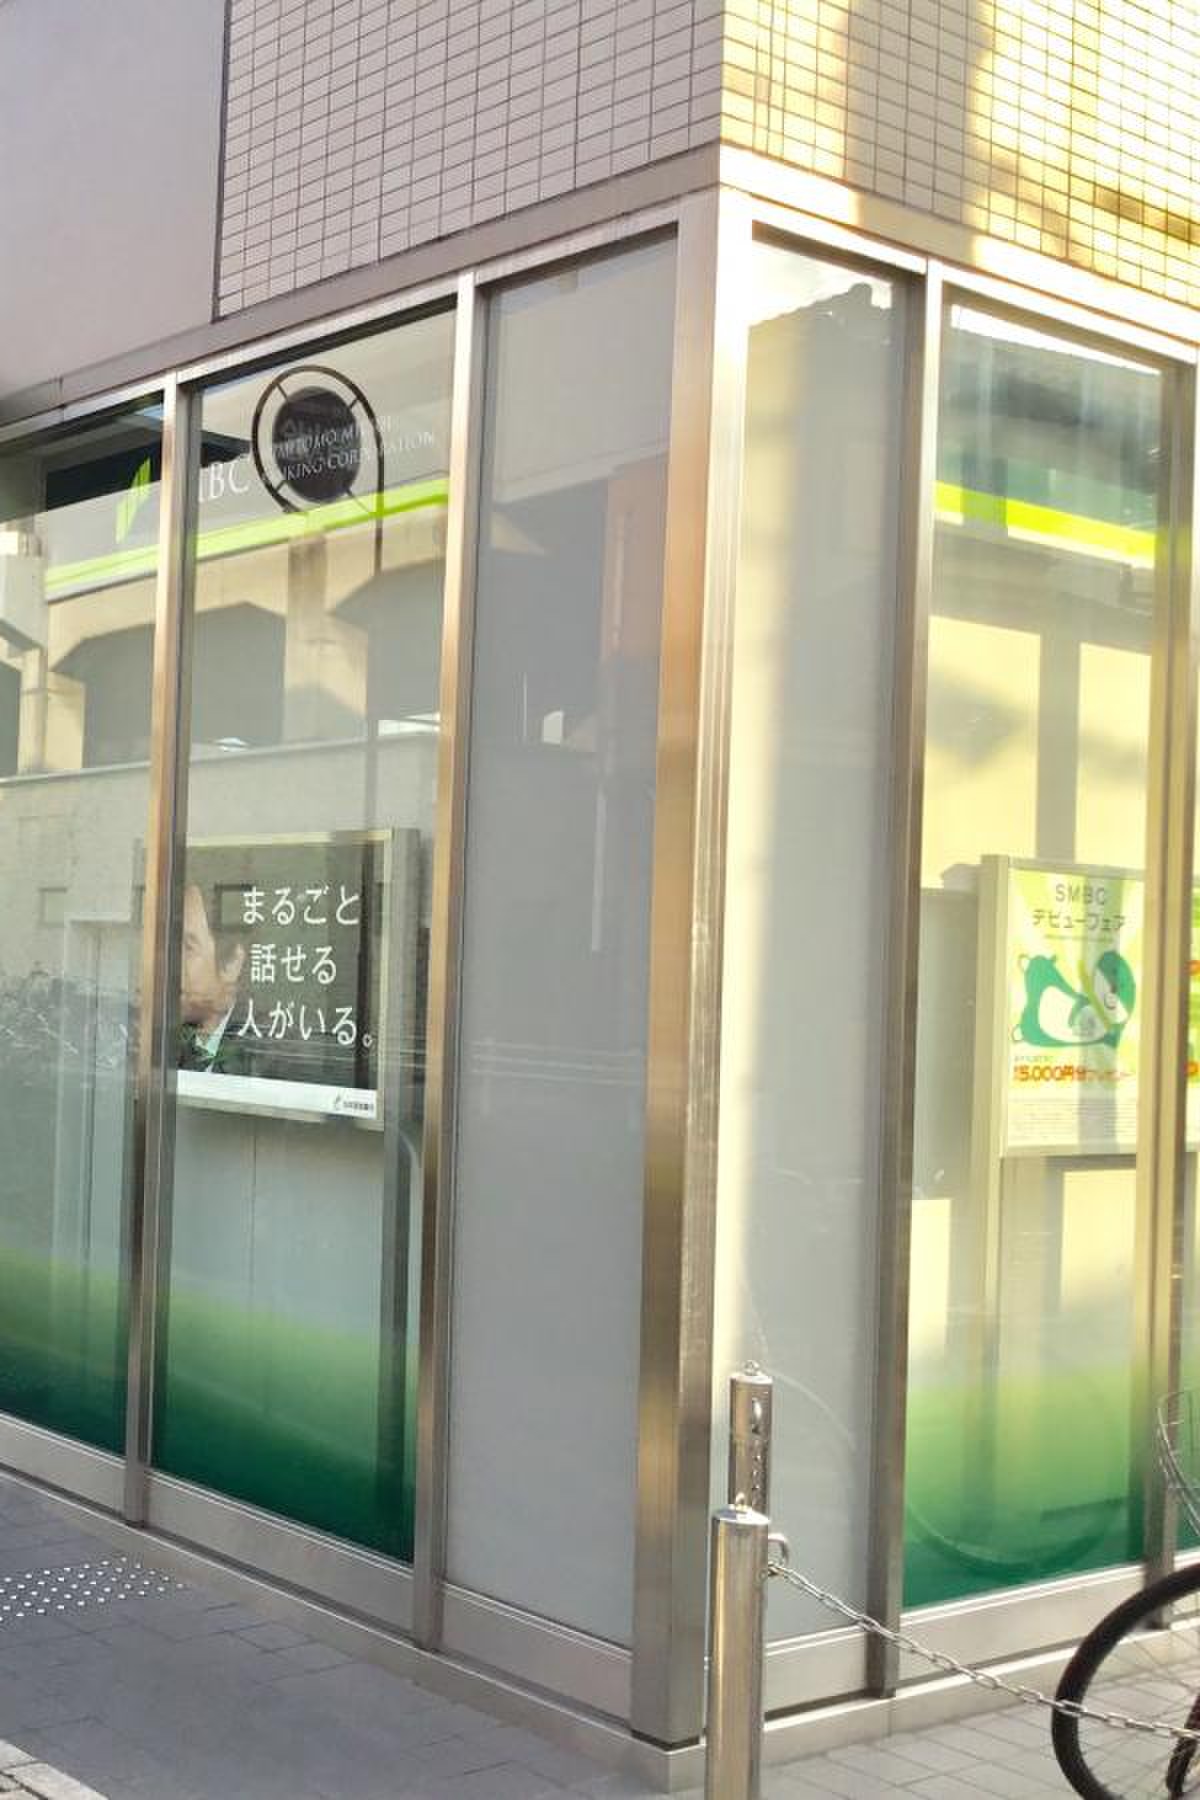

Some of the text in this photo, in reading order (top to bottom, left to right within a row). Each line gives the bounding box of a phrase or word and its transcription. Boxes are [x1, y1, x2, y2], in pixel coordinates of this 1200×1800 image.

[243, 886, 359, 925] まるごと
[251, 943, 337, 984] 話せる
[237, 998, 373, 1045] 人がいる。
